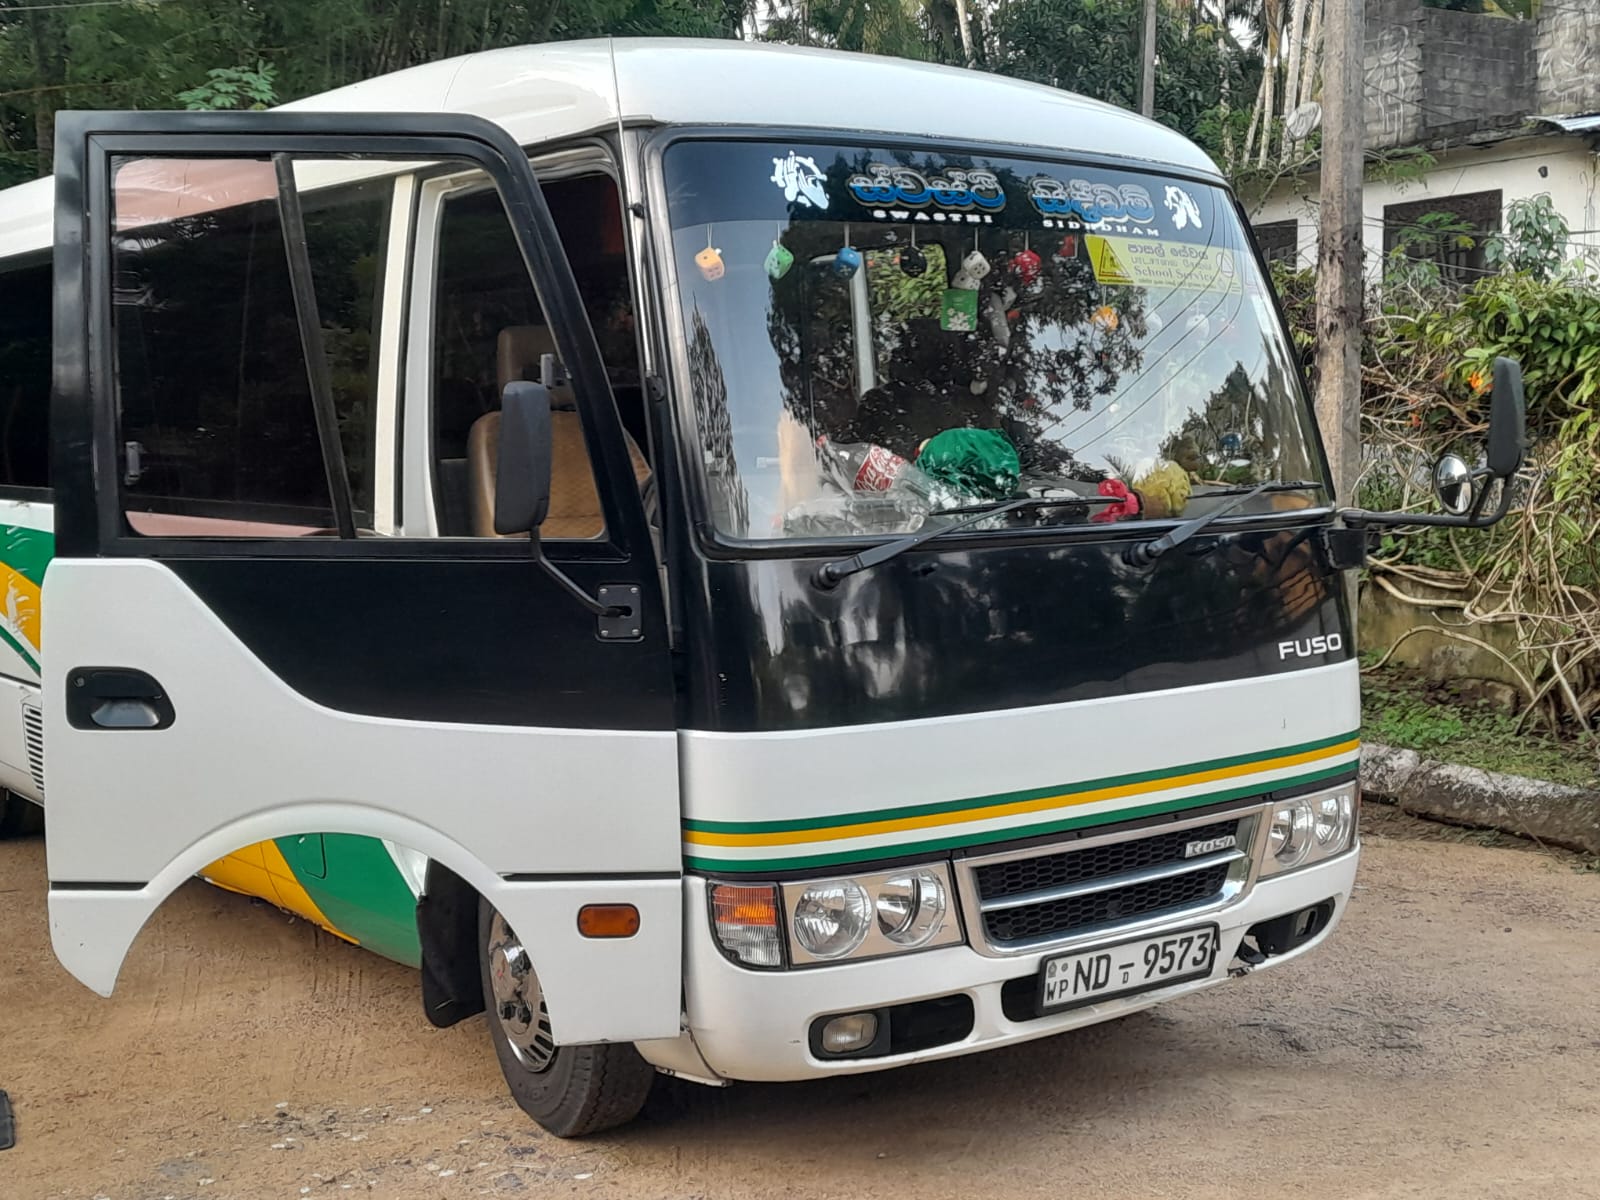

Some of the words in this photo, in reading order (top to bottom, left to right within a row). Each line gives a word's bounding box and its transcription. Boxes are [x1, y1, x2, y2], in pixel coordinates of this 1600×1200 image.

[873, 209, 993, 223] SWASTHI
[1128, 243, 1166, 258] පාසල්
[1134, 266, 1173, 280] School
[1176, 269, 1215, 282] Service
[1278, 633, 1342, 660] FUSO
[1073, 953, 1111, 994] ND
[1144, 932, 1211, 980] 9573
[1046, 978, 1069, 1001] WP
